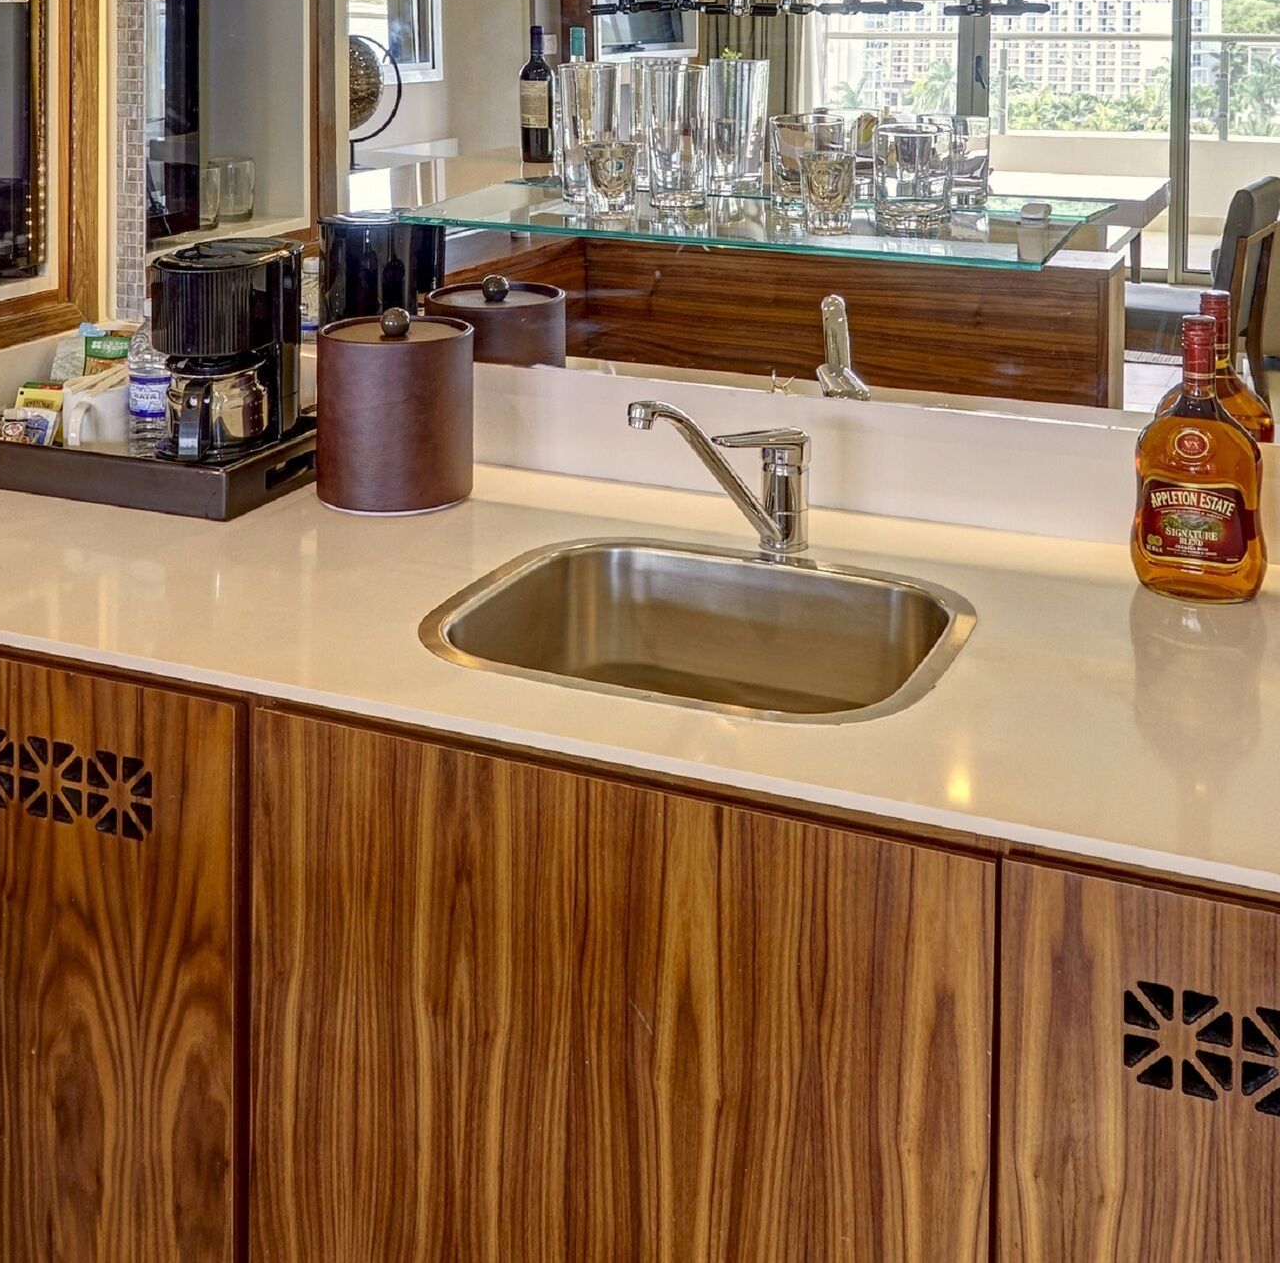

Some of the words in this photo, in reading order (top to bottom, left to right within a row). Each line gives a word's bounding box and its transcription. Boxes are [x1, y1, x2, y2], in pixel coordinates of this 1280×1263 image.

[1150, 490, 1198, 508] APPLETON
[1199, 492, 1235, 517] ESTATE
[1165, 526, 1218, 541] SIGNATURE
[1179, 537, 1204, 547] BLEND
